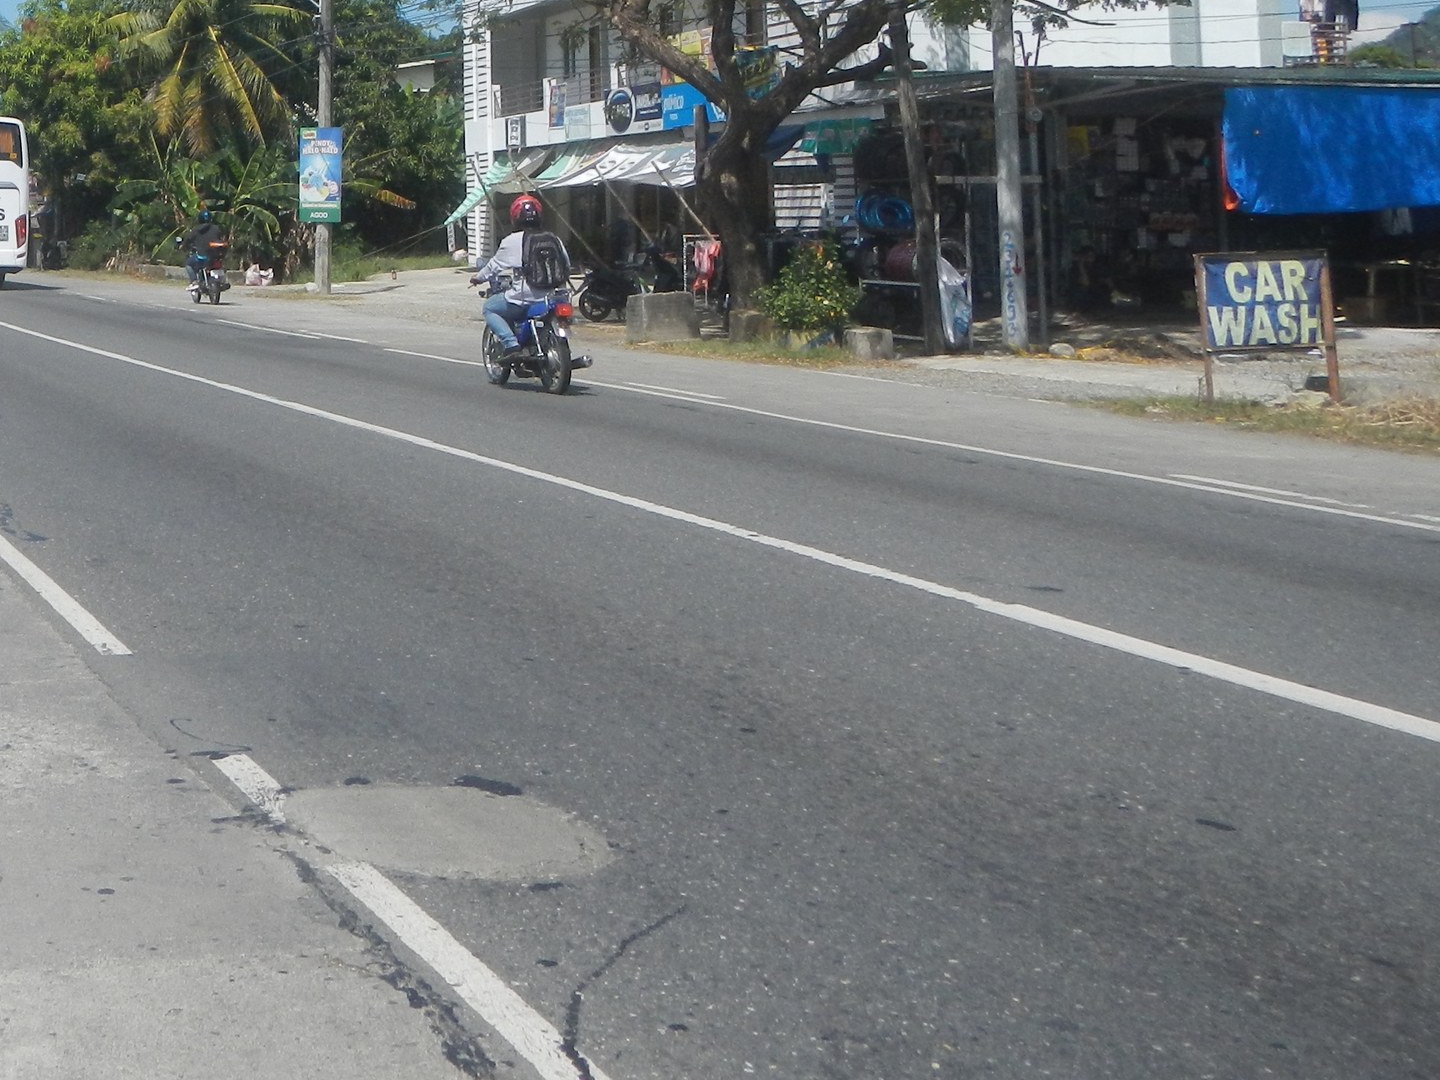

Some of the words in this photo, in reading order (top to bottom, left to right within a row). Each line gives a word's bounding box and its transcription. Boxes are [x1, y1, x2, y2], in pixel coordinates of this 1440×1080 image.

[310, 211, 328, 219] AGOO
[1224, 260, 1309, 303] CAR
[1207, 303, 1323, 346] WASH
